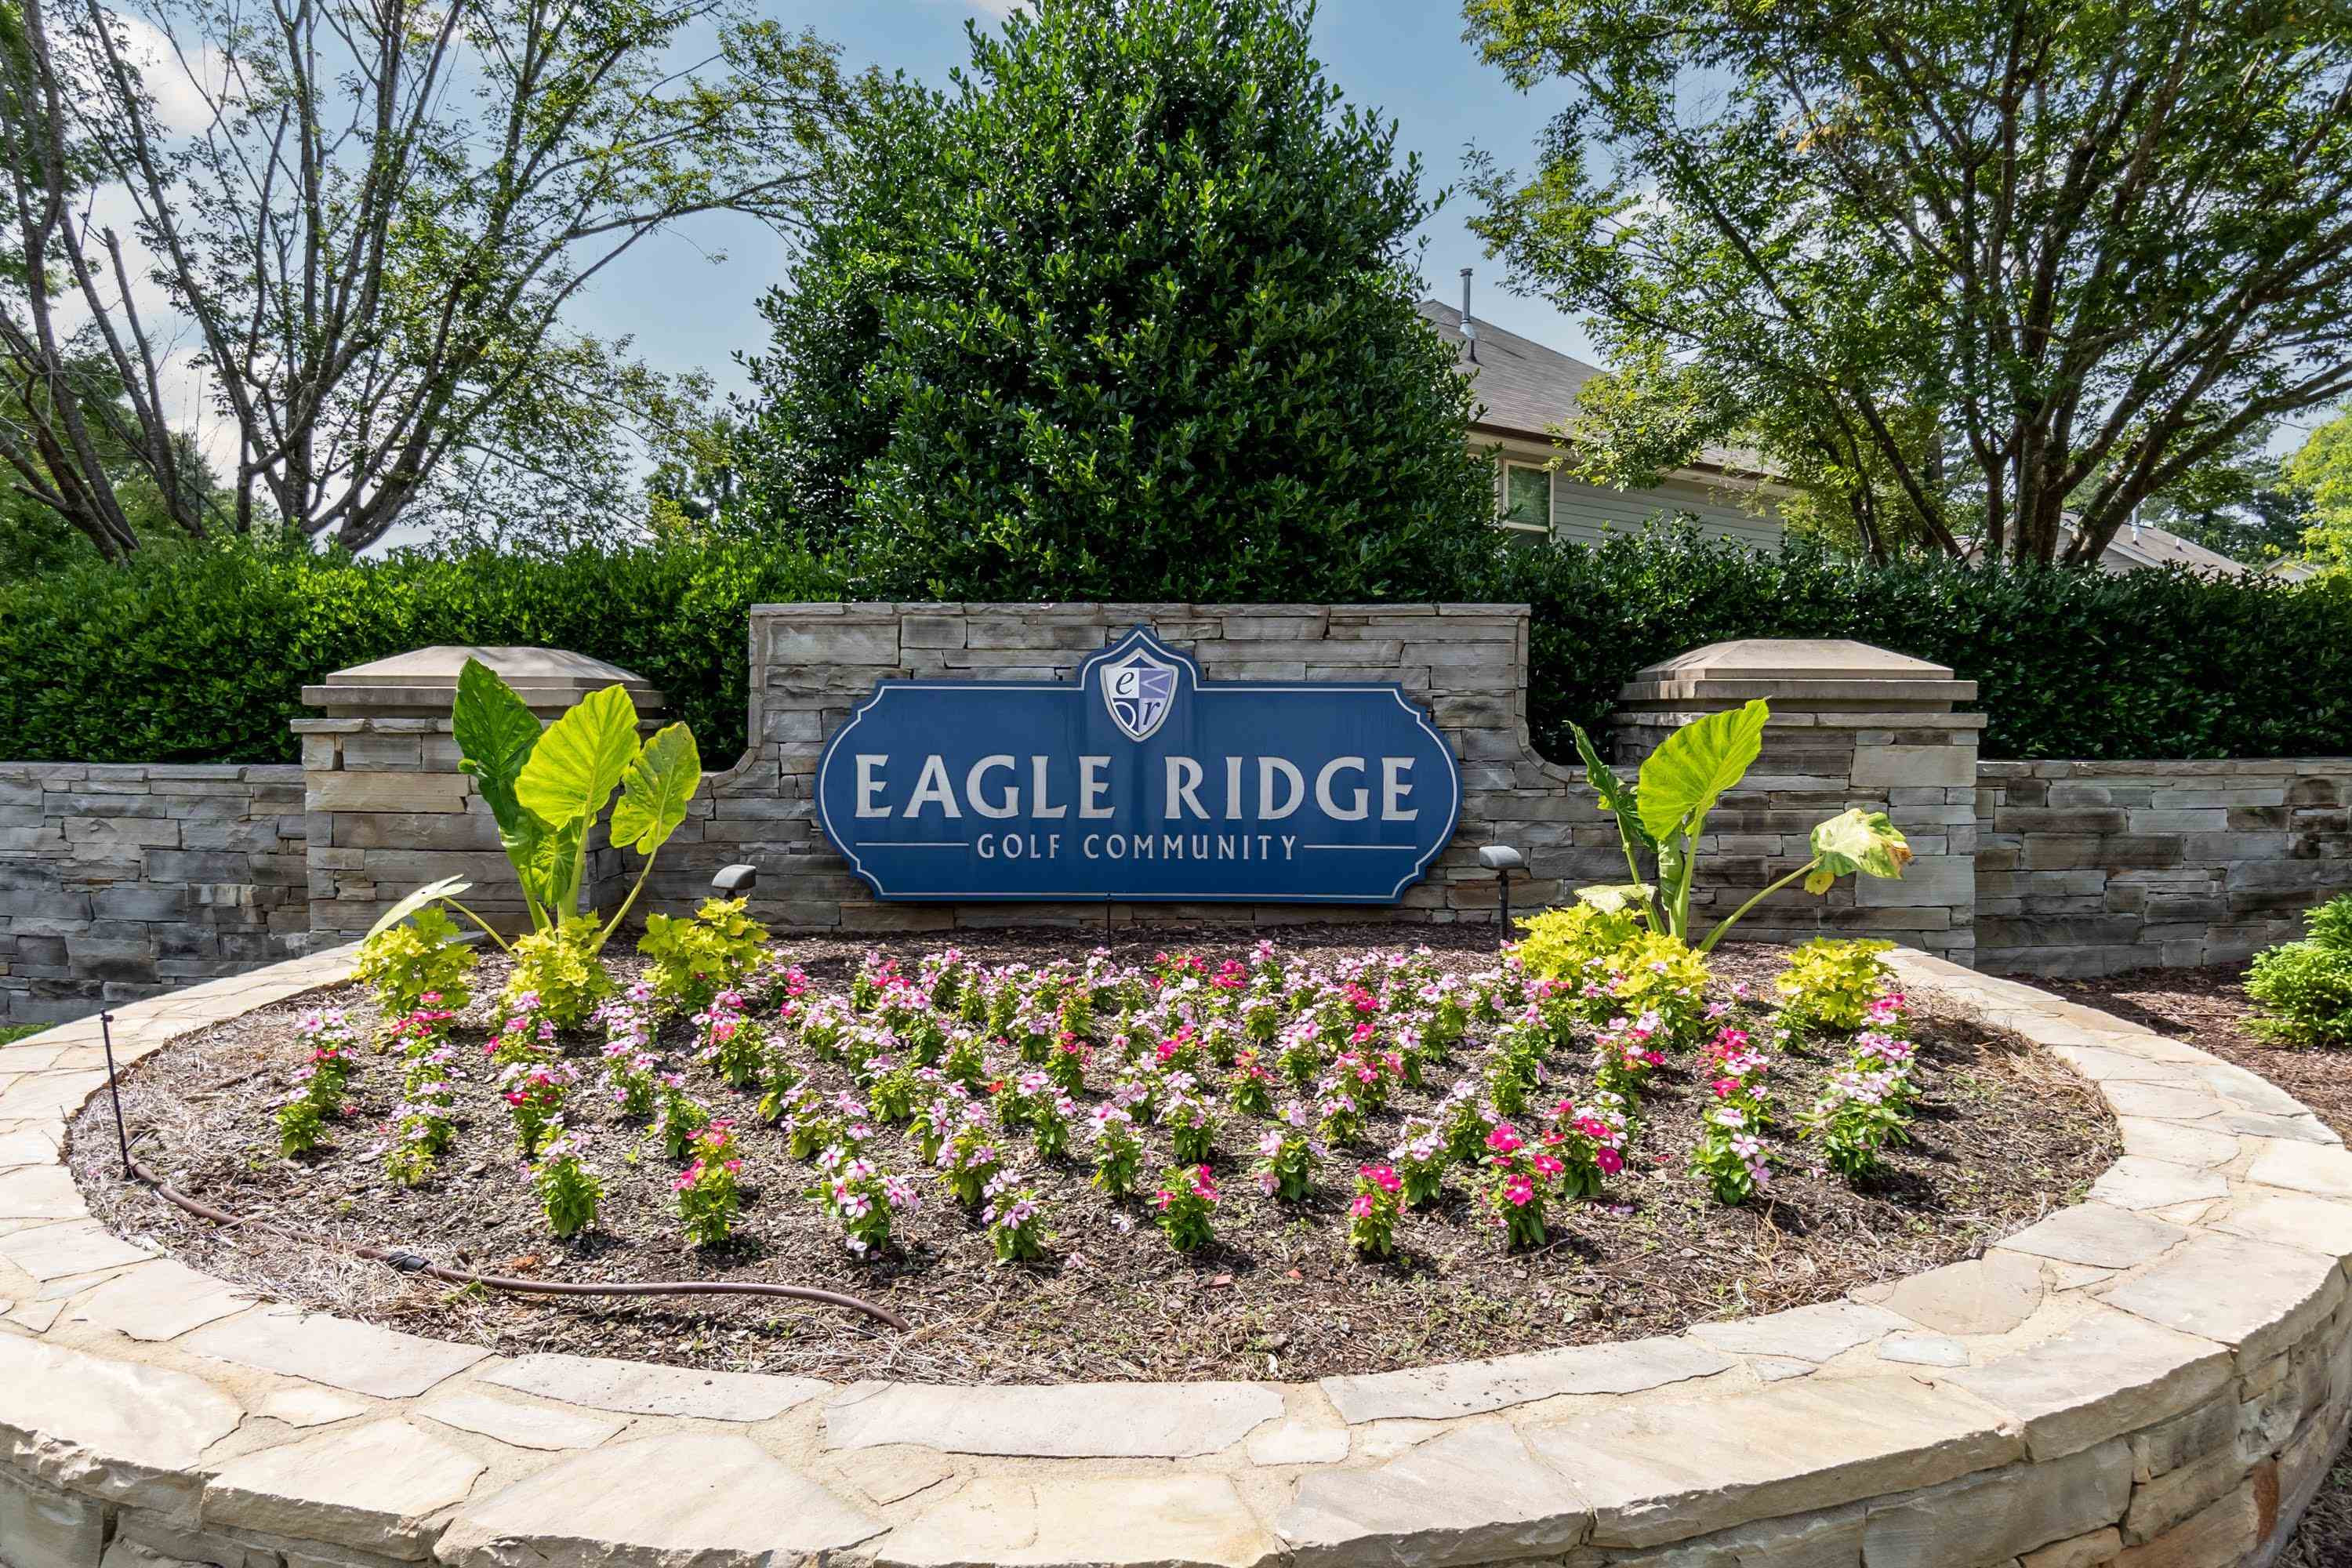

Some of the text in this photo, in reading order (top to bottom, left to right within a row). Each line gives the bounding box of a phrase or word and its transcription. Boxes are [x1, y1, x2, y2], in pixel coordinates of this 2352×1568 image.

[1116, 671, 1135, 695] e
[1143, 701, 1161, 726] r
[855, 754, 1420, 822] EAGLE RIDGE
[977, 833, 1297, 861] GOLF COMMUNITY
